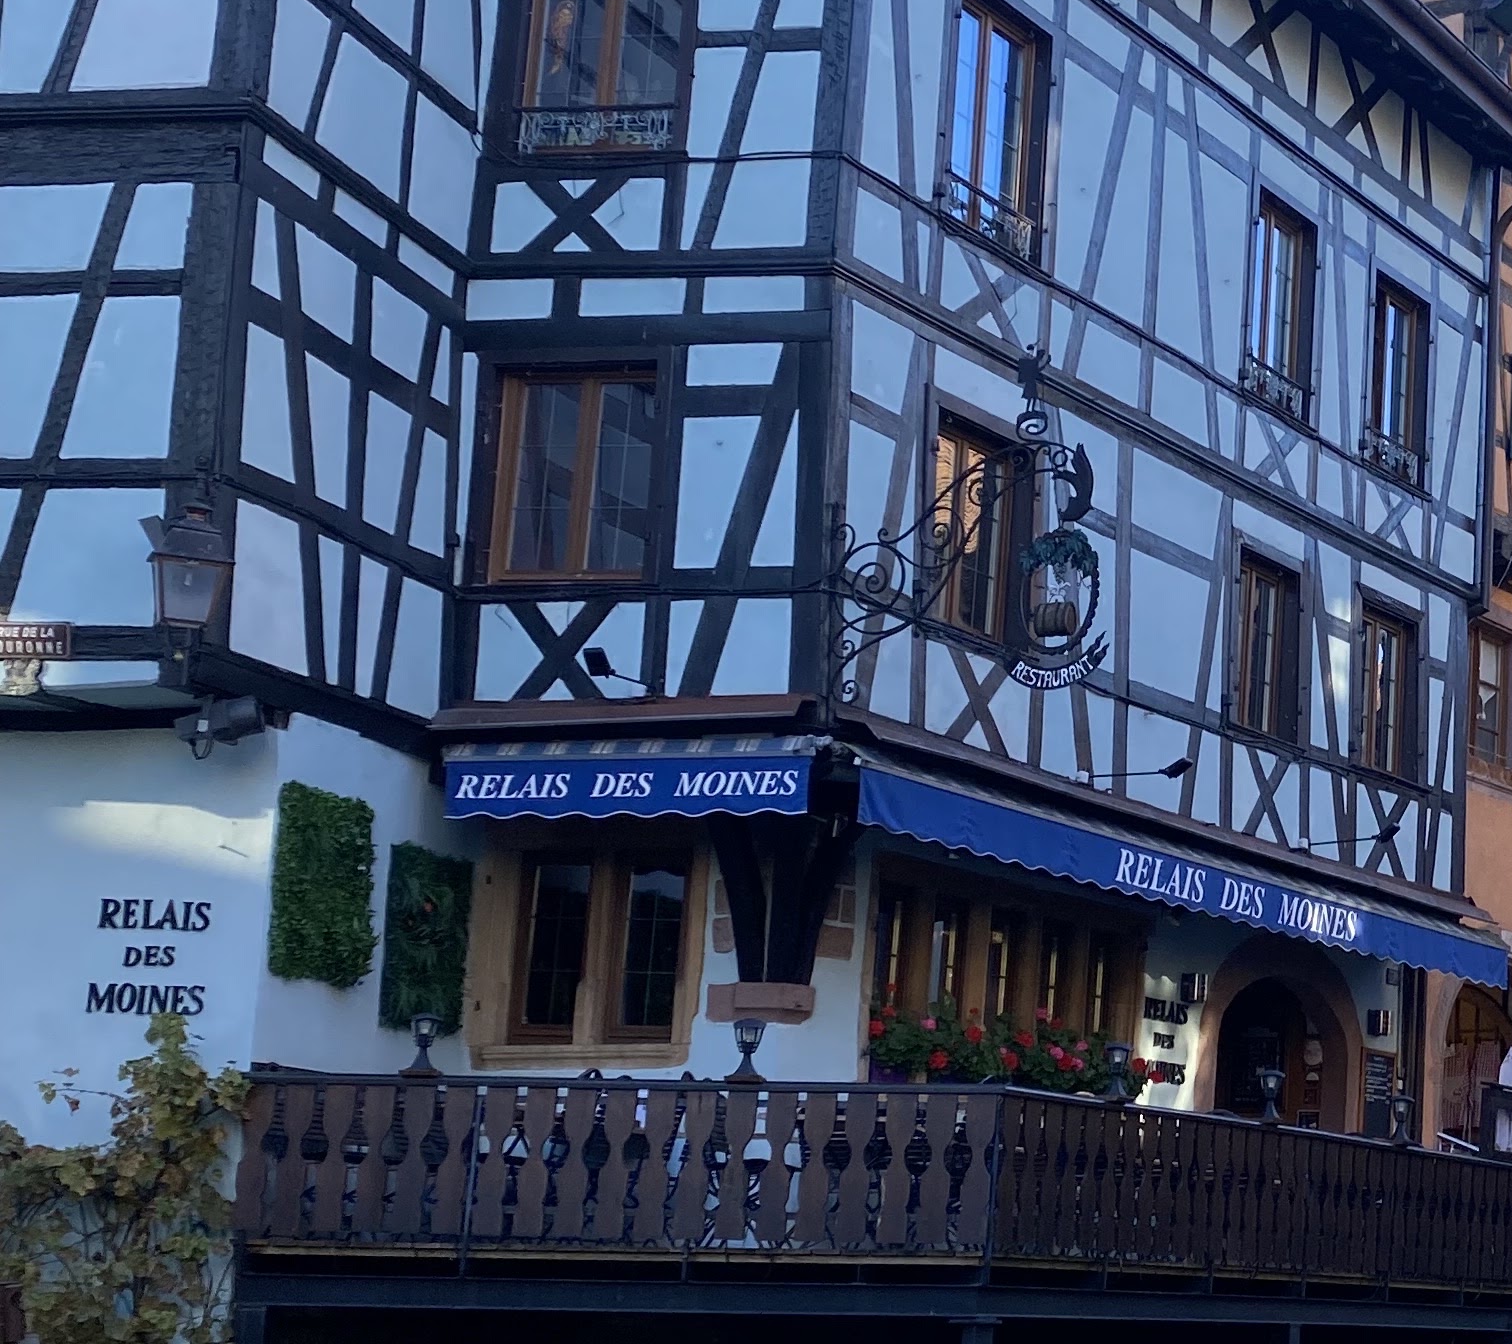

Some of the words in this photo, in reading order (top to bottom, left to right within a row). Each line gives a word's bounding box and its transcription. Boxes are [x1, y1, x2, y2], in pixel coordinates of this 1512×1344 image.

[22, 626, 38, 638] DE
[40, 627, 55, 638] LA
[1010, 654, 1094, 688] RESTAURANT
[454, 773, 571, 799] RELAIS
[590, 772, 654, 798] DES
[673, 770, 799, 797] MOINES
[1115, 848, 1207, 904] RELAIS
[1220, 877, 1266, 920] DES
[1277, 893, 1359, 942] MOINES
[97, 898, 212, 932] RELAIS
[122, 945, 176, 967] DES
[85, 982, 206, 1016] MOINES
[1143, 997, 1190, 1025] RELAIS
[1153, 1031, 1176, 1049] DES
